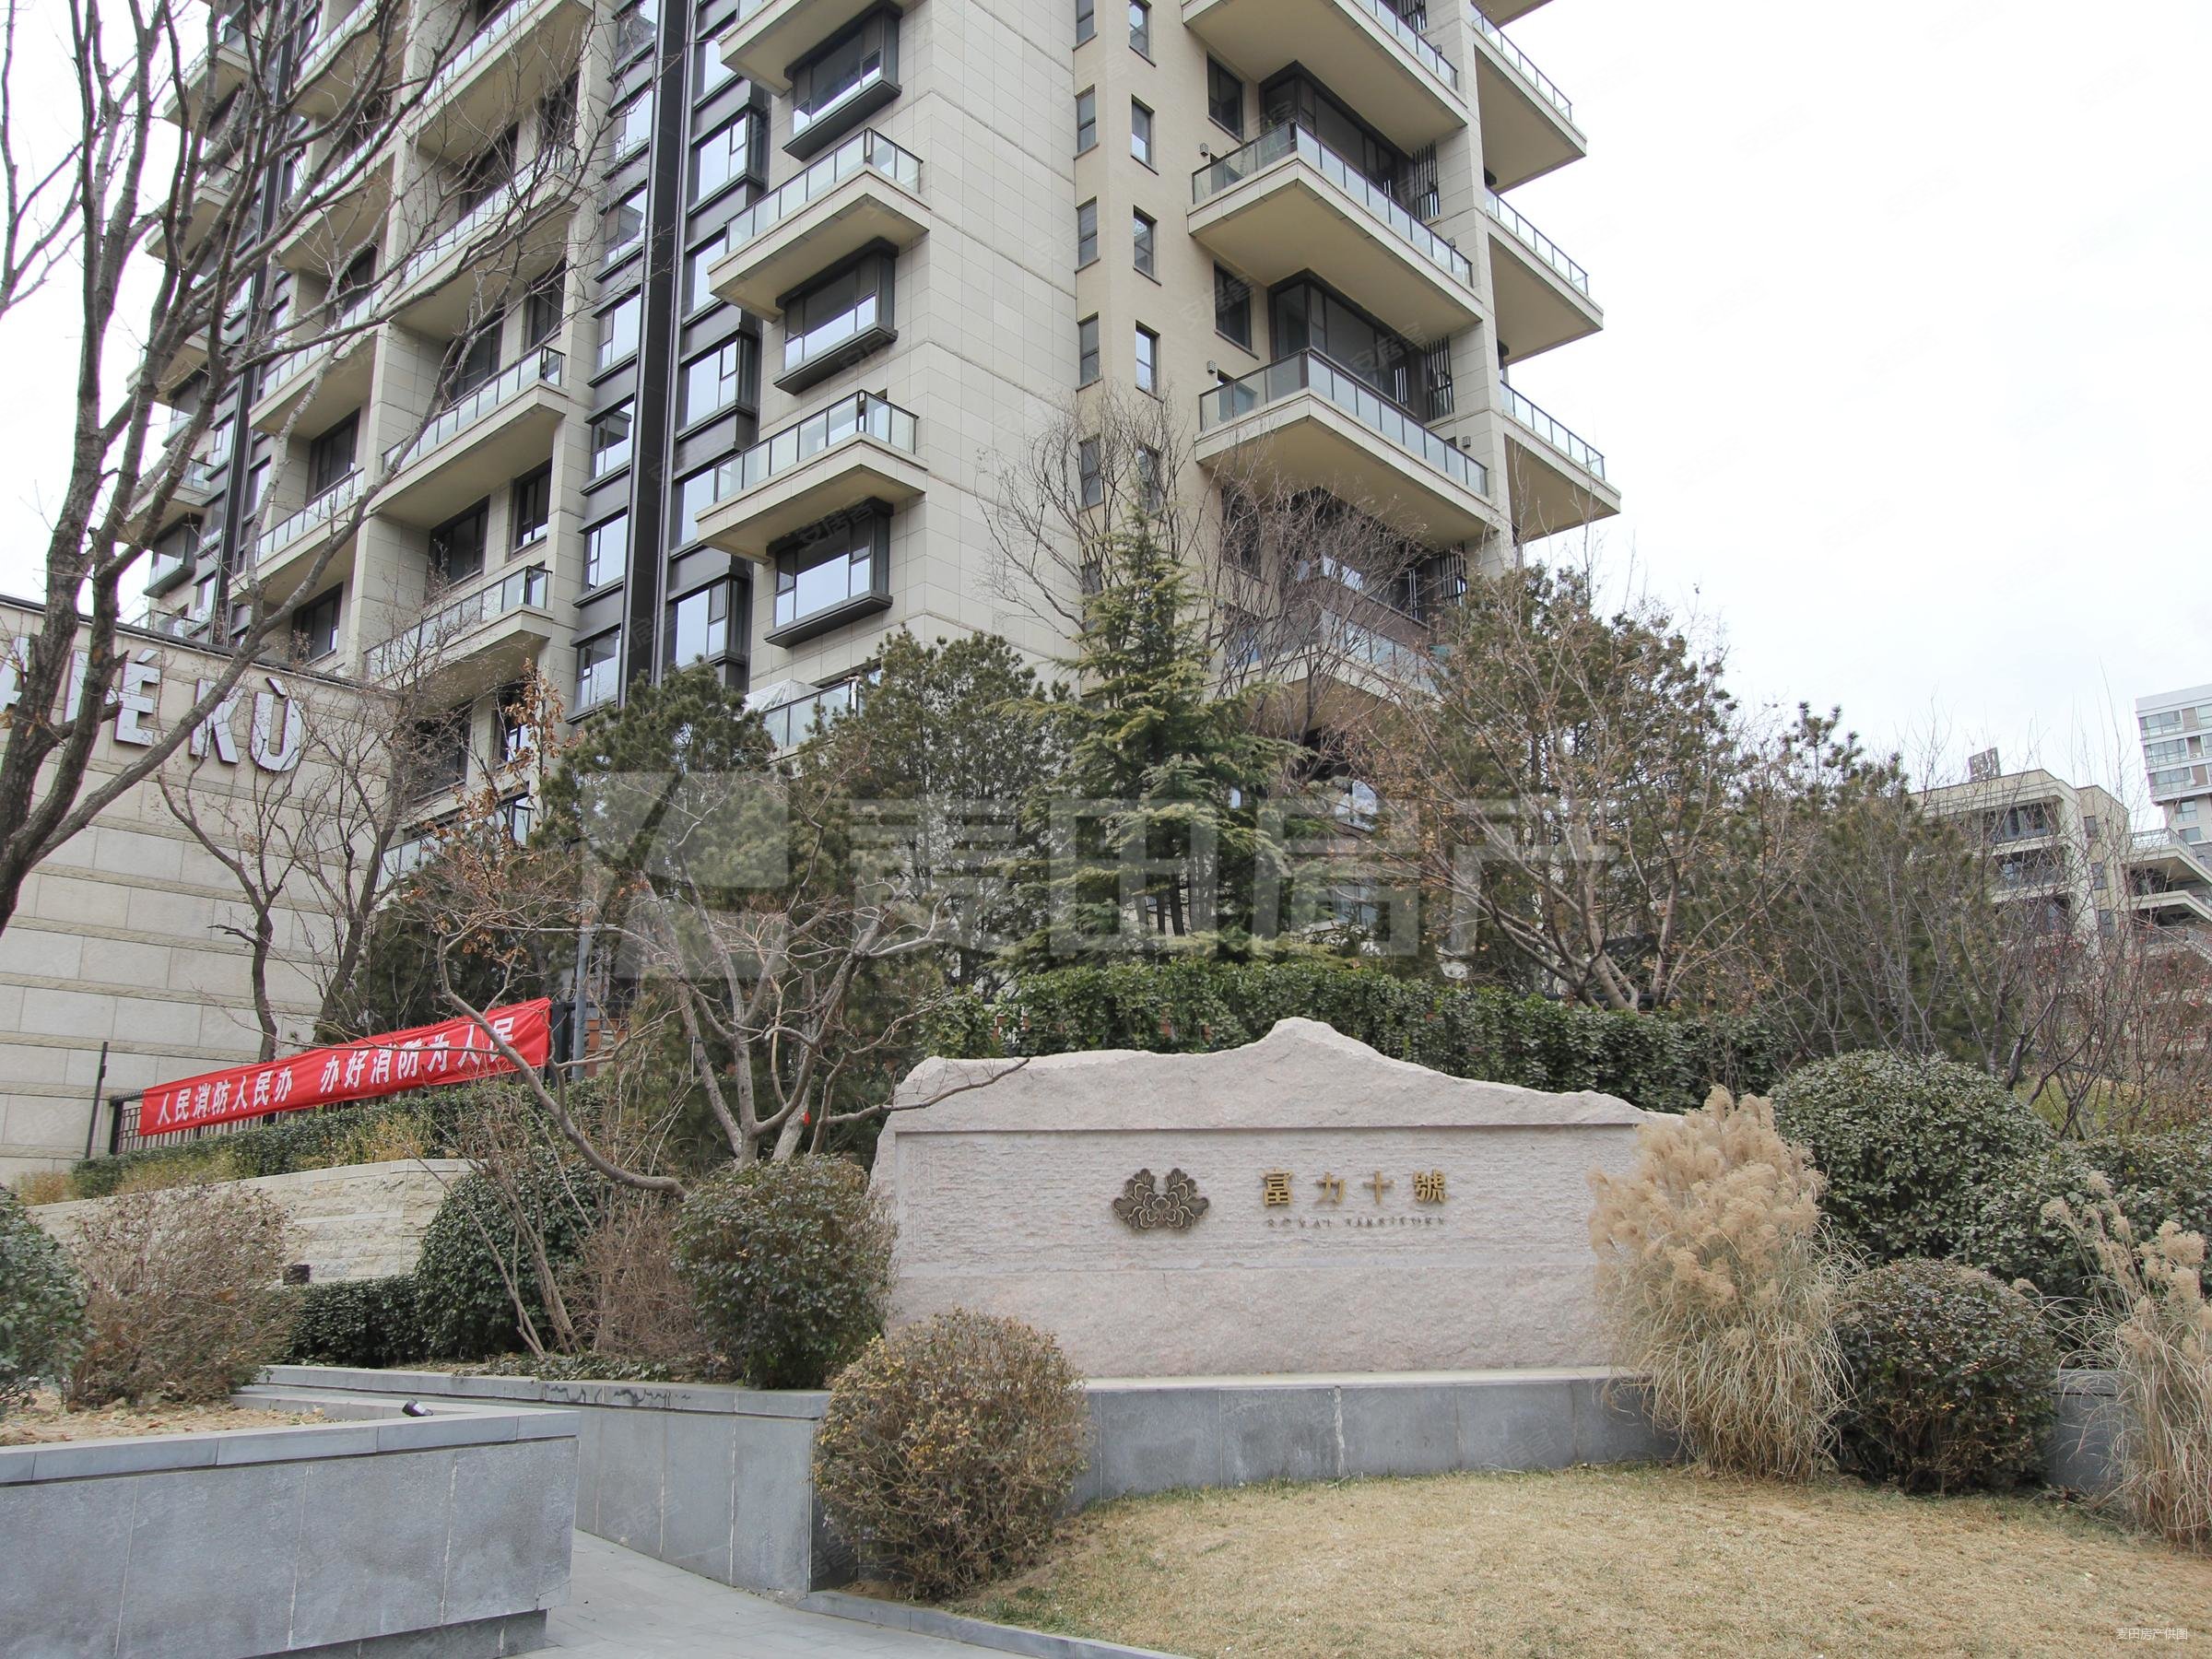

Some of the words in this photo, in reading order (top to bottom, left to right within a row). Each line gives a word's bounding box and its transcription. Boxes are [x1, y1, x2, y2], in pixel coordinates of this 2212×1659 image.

[157, 1065, 293, 1126] 人民消防人民办
[320, 1016, 515, 1094] 办好消防为人民
[1261, 1168, 1448, 1206] 富力十號
